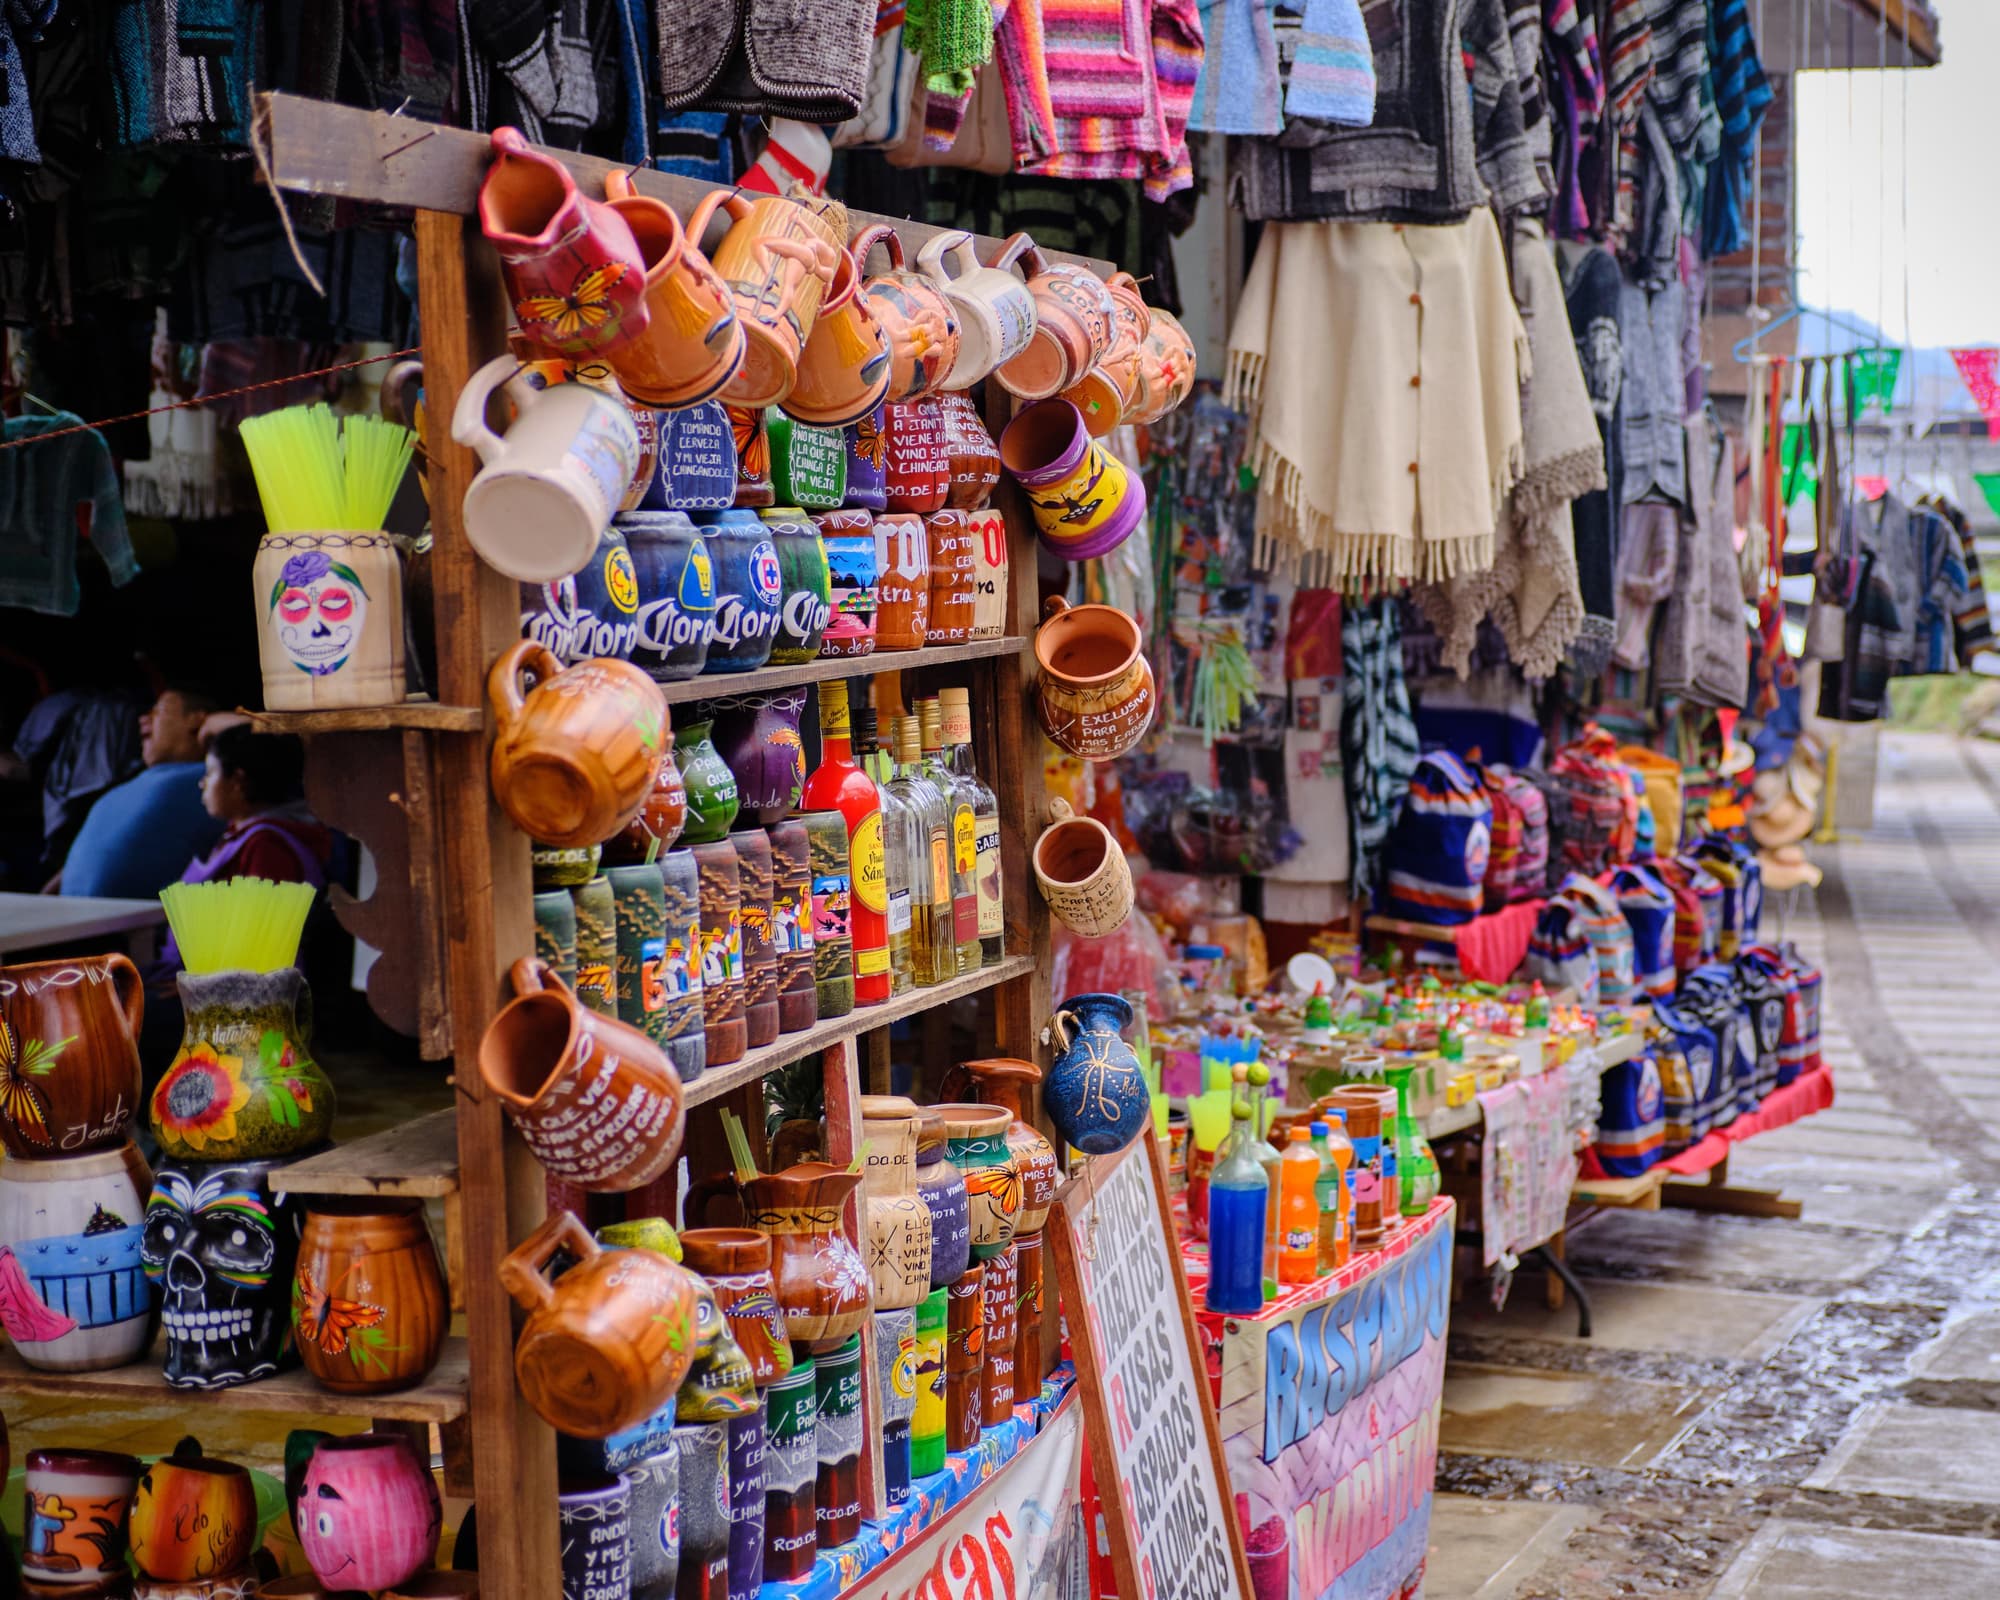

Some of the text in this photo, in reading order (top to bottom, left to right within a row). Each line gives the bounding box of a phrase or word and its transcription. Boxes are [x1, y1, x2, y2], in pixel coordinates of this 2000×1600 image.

[692, 408, 704, 420] YO
[893, 405, 914, 418] EL
[680, 422, 722, 437] TOMANDO
[893, 419, 903, 432] A
[679, 437, 720, 450] CERVEZA
[893, 432, 934, 447] VIENE
[809, 446, 826, 461] QUE
[828, 449, 840, 464] ME
[894, 447, 927, 460] VINO
[796, 470, 807, 483] MI
[826, 463, 837, 477] ES
[1081, 688, 1149, 727] EXCLUSIVO
[1082, 711, 1145, 737] PARA EL
[1081, 738, 1108, 746] MAS
[1023, 1169, 1046, 1182] MAS
[1034, 1180, 1050, 1193] DE
[974, 1223, 991, 1243] de
[903, 1248, 930, 1258] VIENE
[903, 1261, 926, 1272] VINO
[1088, 1223, 1165, 1378] DIABLITOS
[757, 1356, 774, 1377] de
[1110, 1308, 1174, 1454] RUSAS
[1122, 1381, 1196, 1546] RASPADOS
[1141, 1463, 1209, 1600] PALOMAS
[584, 1550, 598, 1568] Y
[584, 1569, 607, 1587] 24
